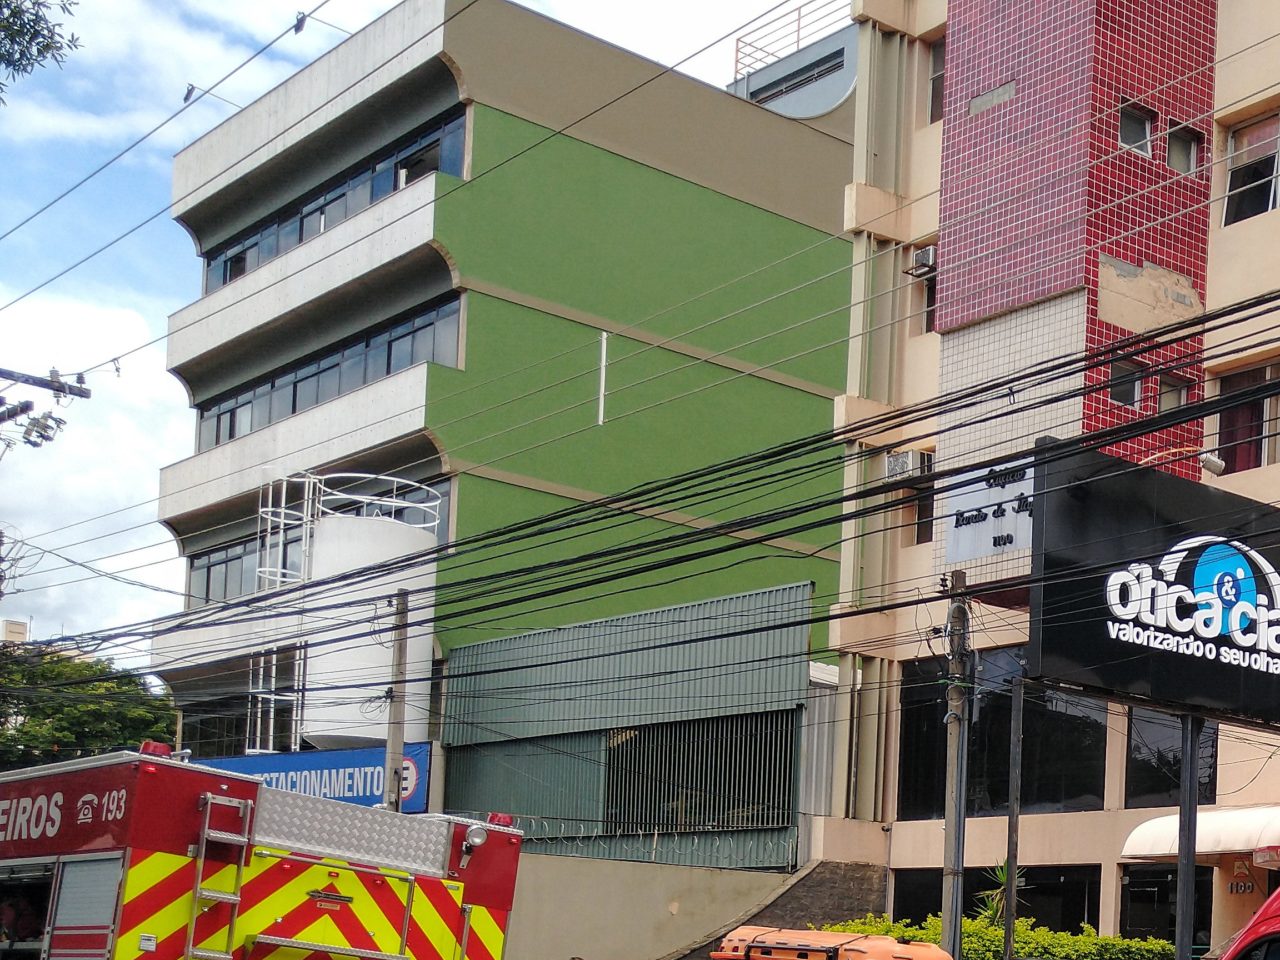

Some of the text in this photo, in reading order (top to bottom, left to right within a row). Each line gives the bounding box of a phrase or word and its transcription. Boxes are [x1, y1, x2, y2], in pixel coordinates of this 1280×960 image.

[1107, 563, 1223, 639] ótica
[1106, 620, 1204, 658] valorizando
[1203, 643, 1217, 660] o
[1219, 645, 1250, 669] seu
[254, 766, 384, 798] STACIONAMENTO
[102, 789, 127, 821] 193
